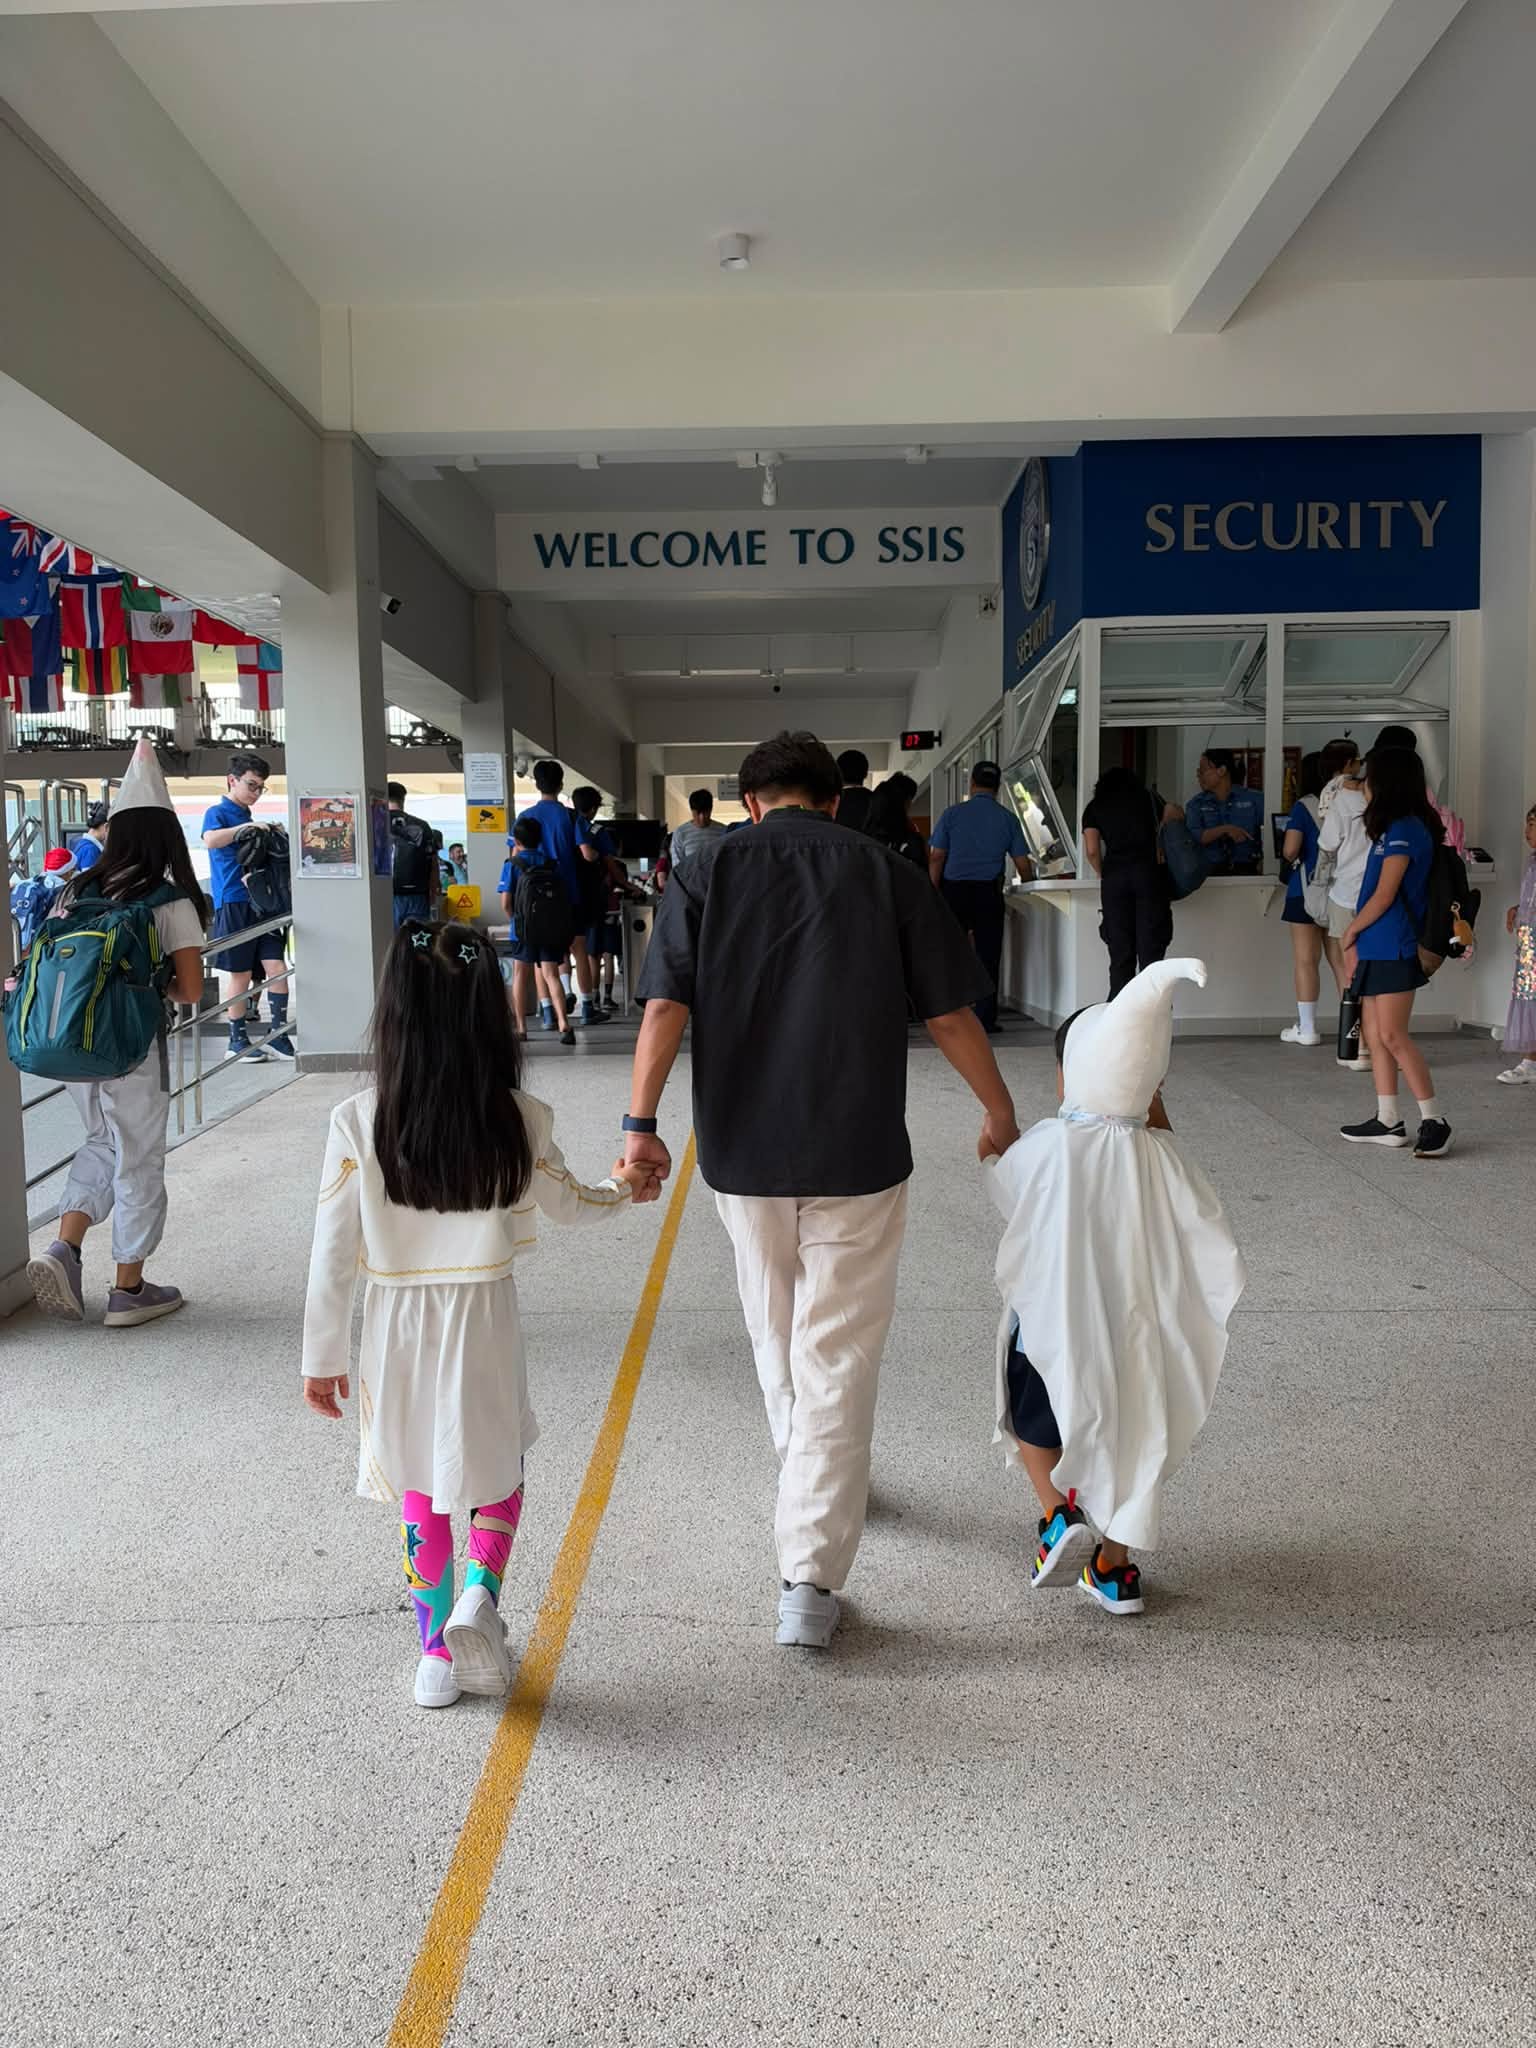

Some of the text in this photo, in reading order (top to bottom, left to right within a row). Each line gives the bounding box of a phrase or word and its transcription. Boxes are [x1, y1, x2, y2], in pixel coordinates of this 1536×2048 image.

[533, 525, 966, 569] WELCOME TO SSIS
[1144, 499, 1448, 553] SECURITY
